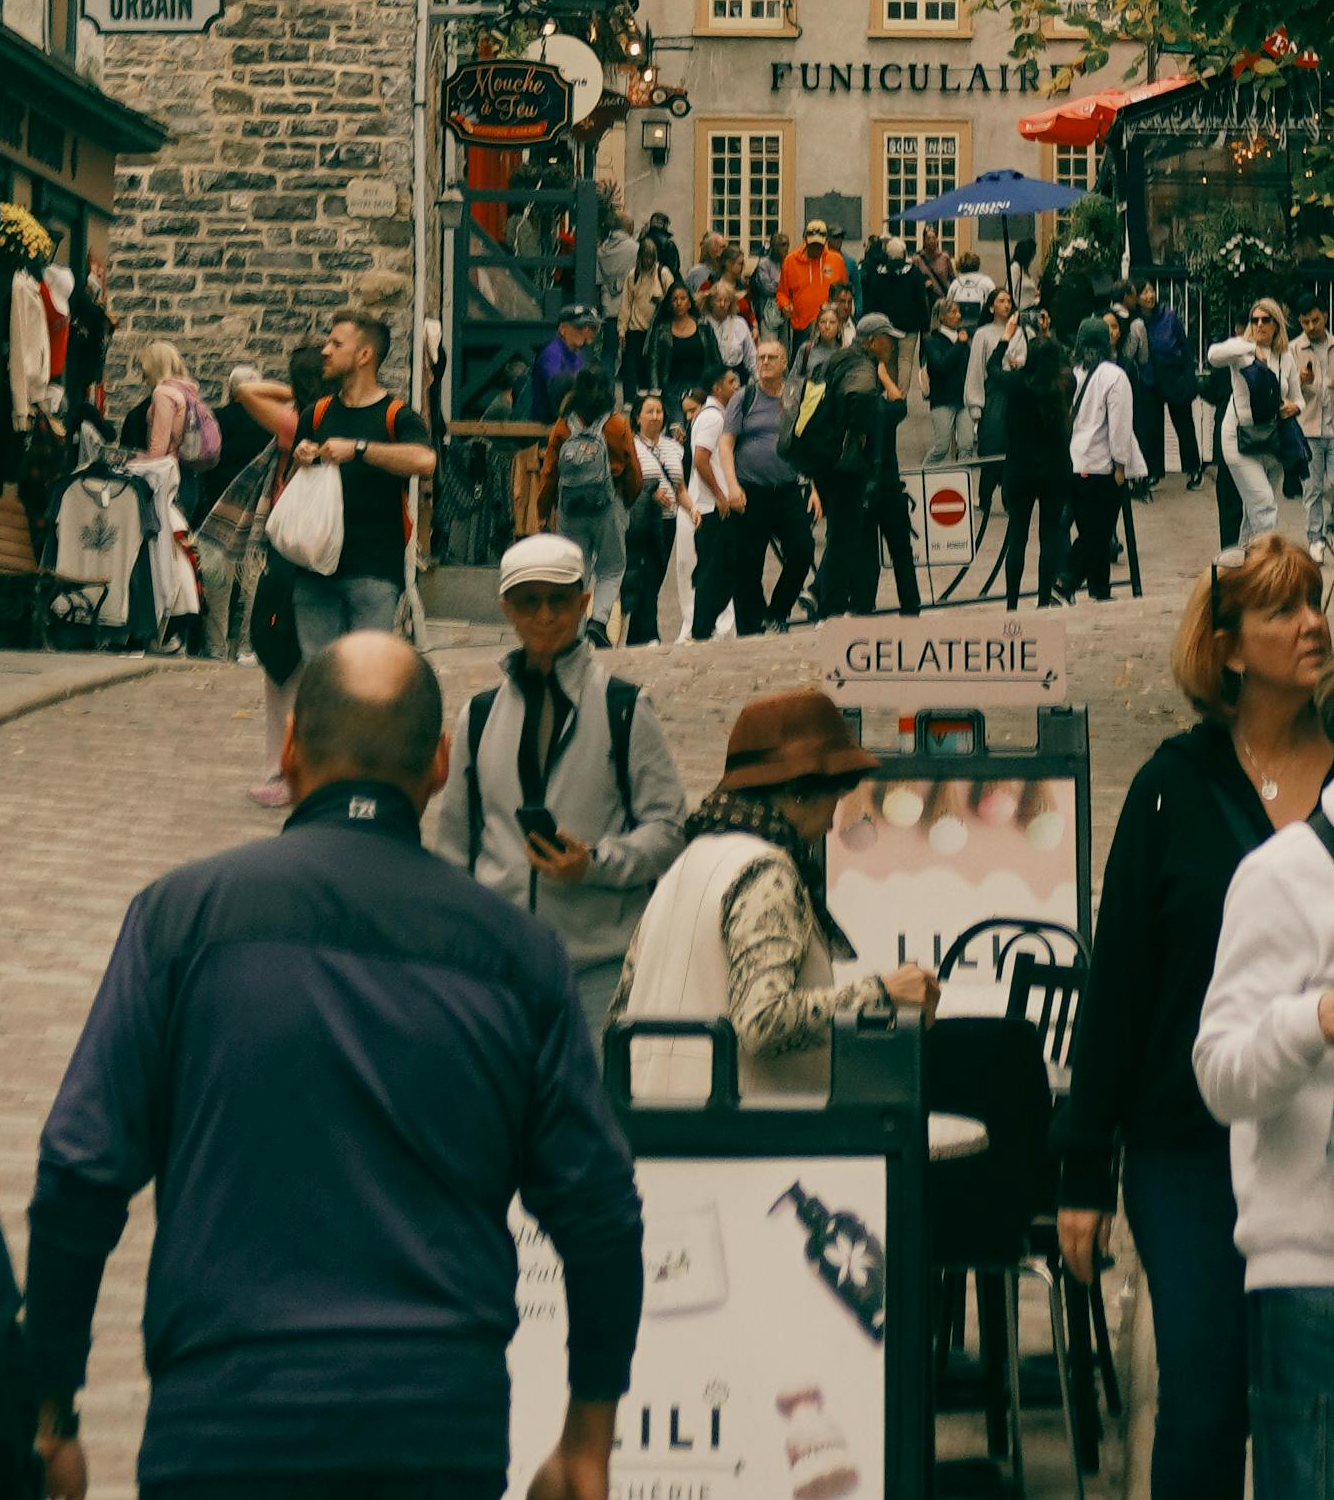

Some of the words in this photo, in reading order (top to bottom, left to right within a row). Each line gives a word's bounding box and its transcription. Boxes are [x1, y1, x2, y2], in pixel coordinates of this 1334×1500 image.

[457, 64, 546, 101] Mouche
[845, 636, 1039, 673] GELATERIE
[612, 1404, 721, 1452] ILI
